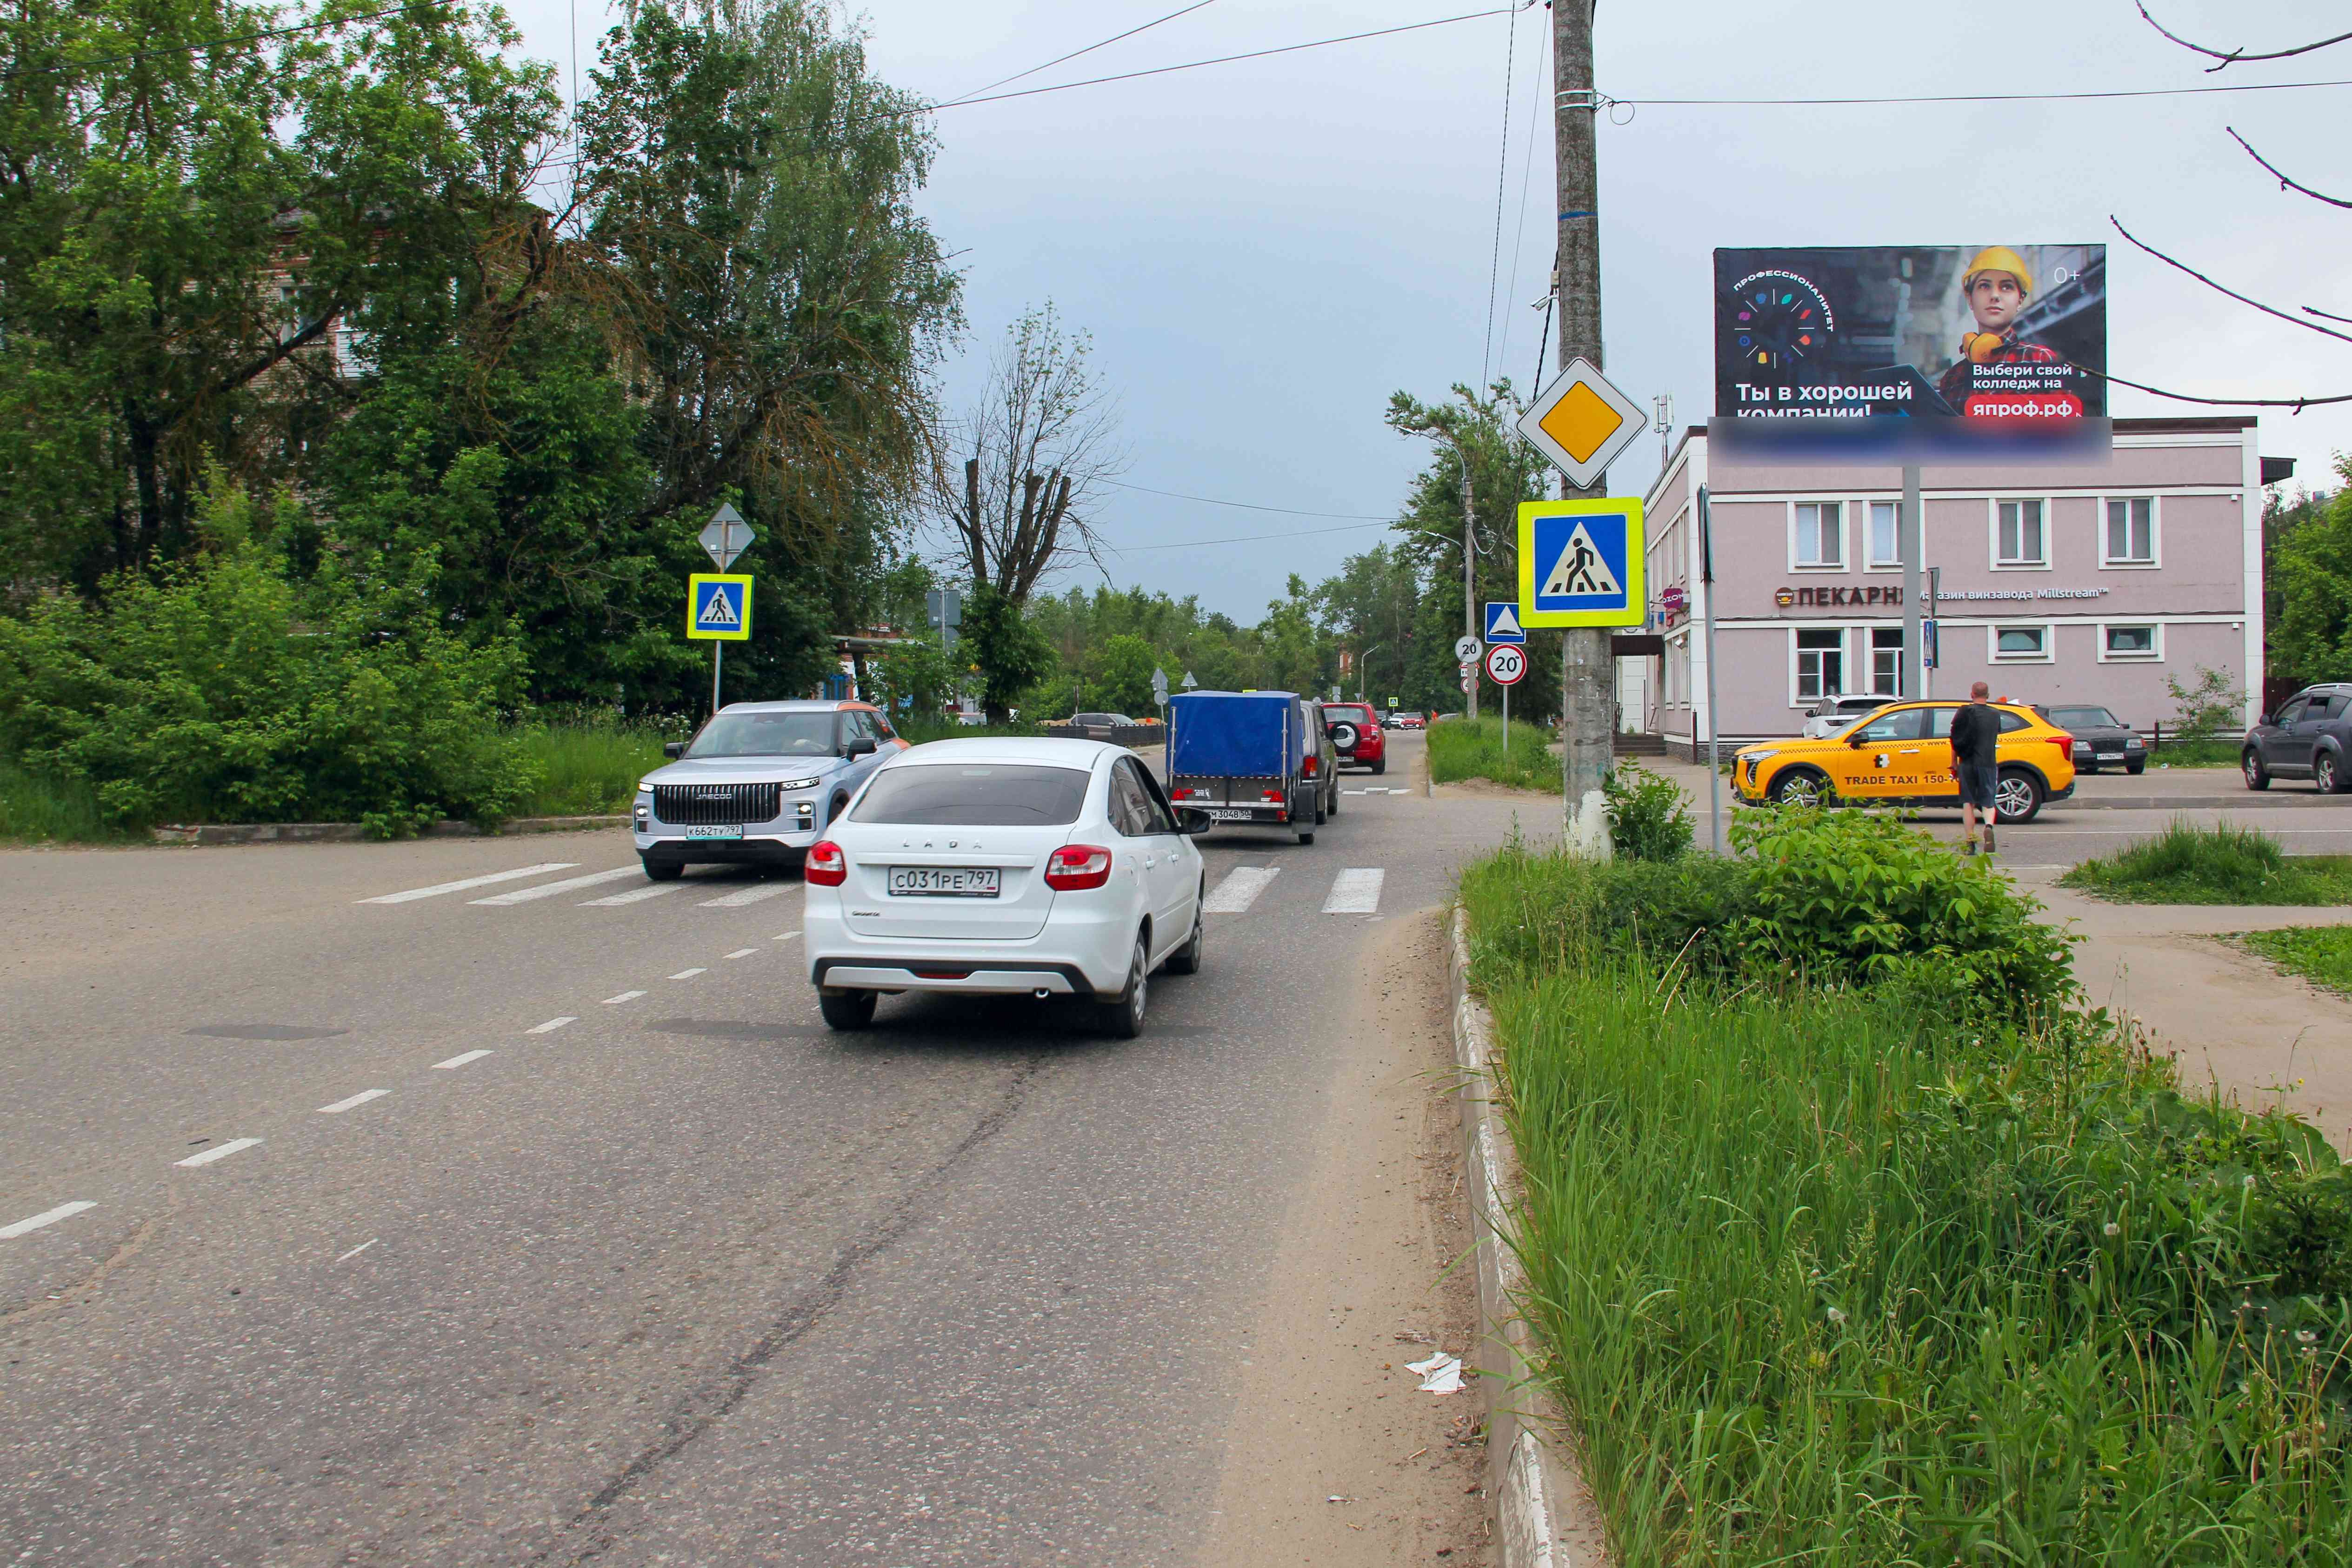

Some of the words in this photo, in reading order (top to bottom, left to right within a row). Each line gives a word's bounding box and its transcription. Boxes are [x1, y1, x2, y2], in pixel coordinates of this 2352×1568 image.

[2054, 267, 2080, 284] 0+
[1733, 270, 1834, 332] ПРОФЕССИОНАЛИТЕТ
[1973, 364, 2032, 378] Выбери
[2036, 363, 2072, 376] свой
[1973, 379, 2040, 390] колледж
[2044, 379, 2062, 389] на
[1735, 384, 1770, 401] Ты
[1778, 386, 1792, 401] в
[1799, 380, 1912, 405] хорошей
[1973, 400, 2072, 417] япроф.рф
[1663, 593, 1684, 603] OZON
[1799, 586, 1903, 606] ПЕКАРН
[1969, 590, 2033, 600] винзавода
[1462, 644, 1477, 655] 20
[1494, 656, 1517, 672] 20
[1845, 776, 1886, 784] TRADE
[1890, 776, 1918, 784] TAXI
[903, 839, 982, 849] LADA
